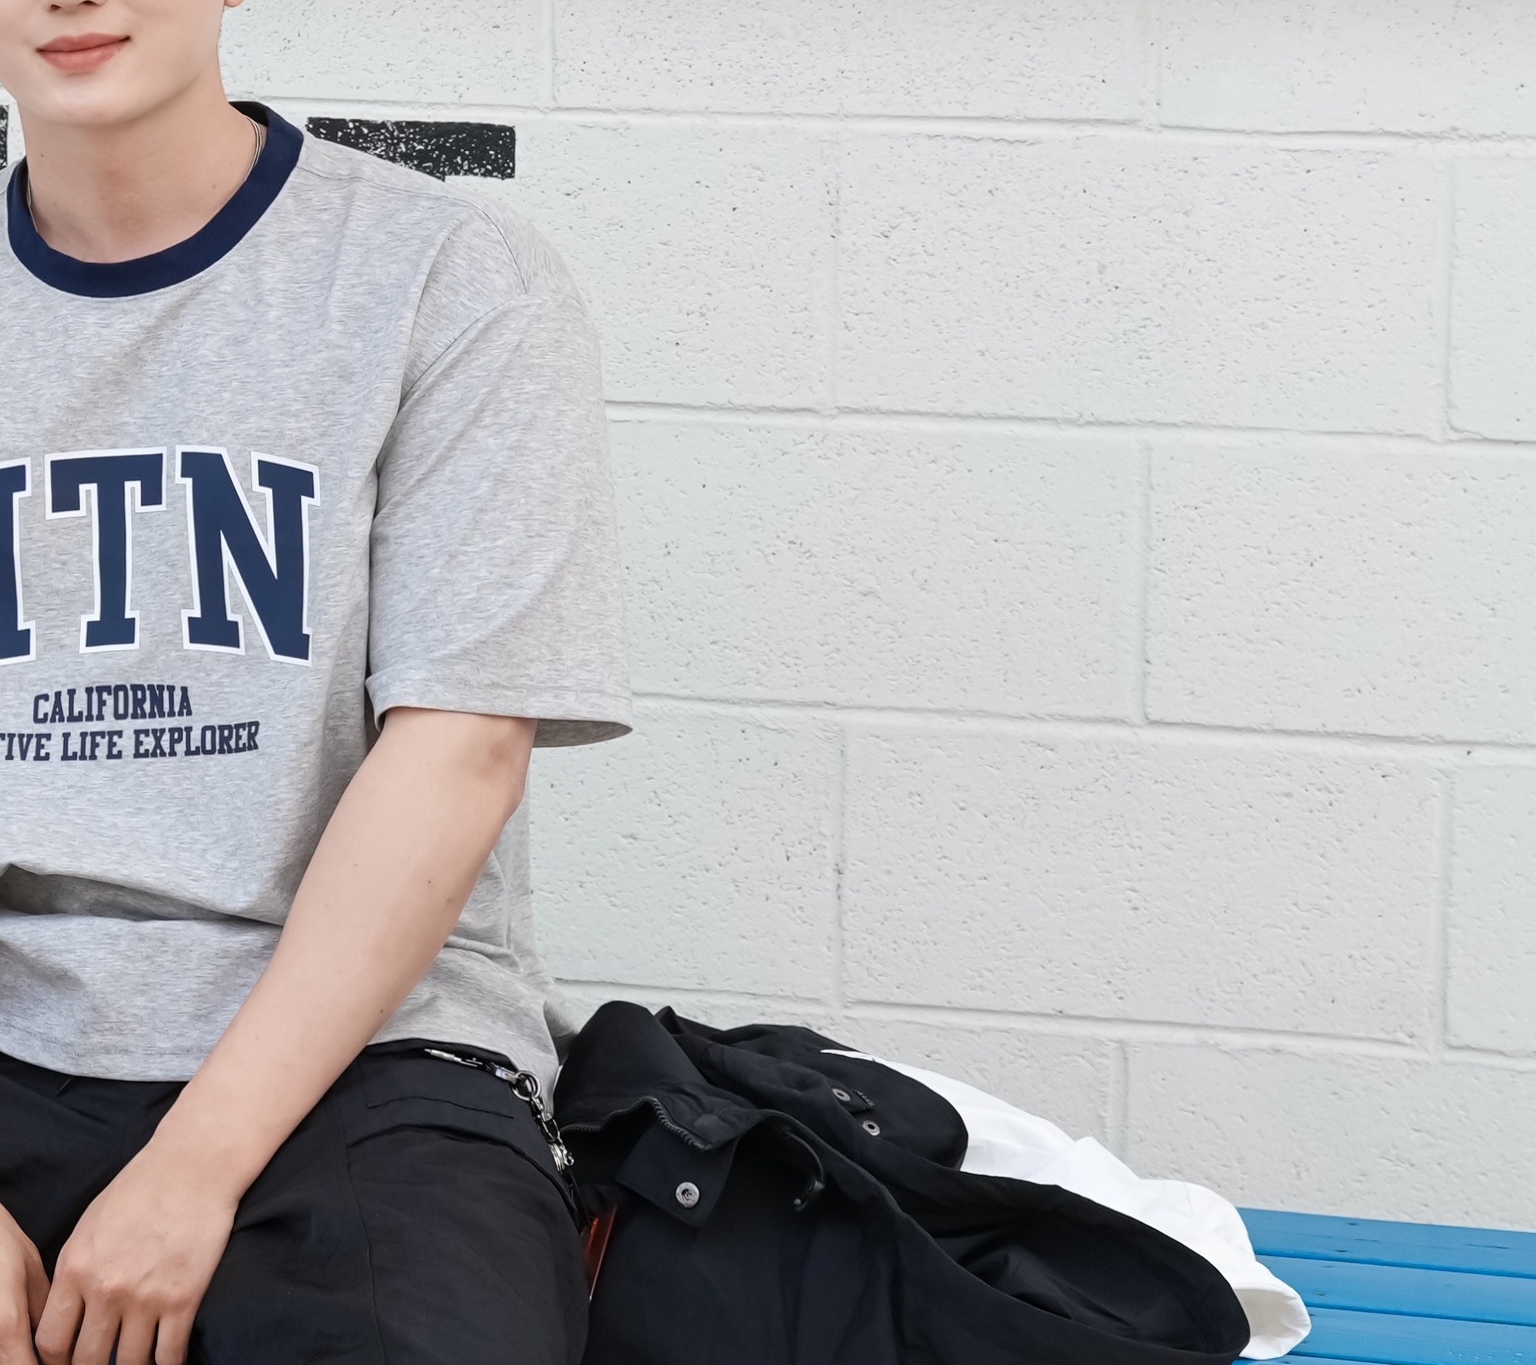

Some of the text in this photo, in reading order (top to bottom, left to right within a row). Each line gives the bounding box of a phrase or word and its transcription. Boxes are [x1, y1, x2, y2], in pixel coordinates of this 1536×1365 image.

[33, 684, 192, 723] CALIFORNIA
[61, 730, 123, 761] LIFE
[133, 721, 260, 759] EXPLORER
